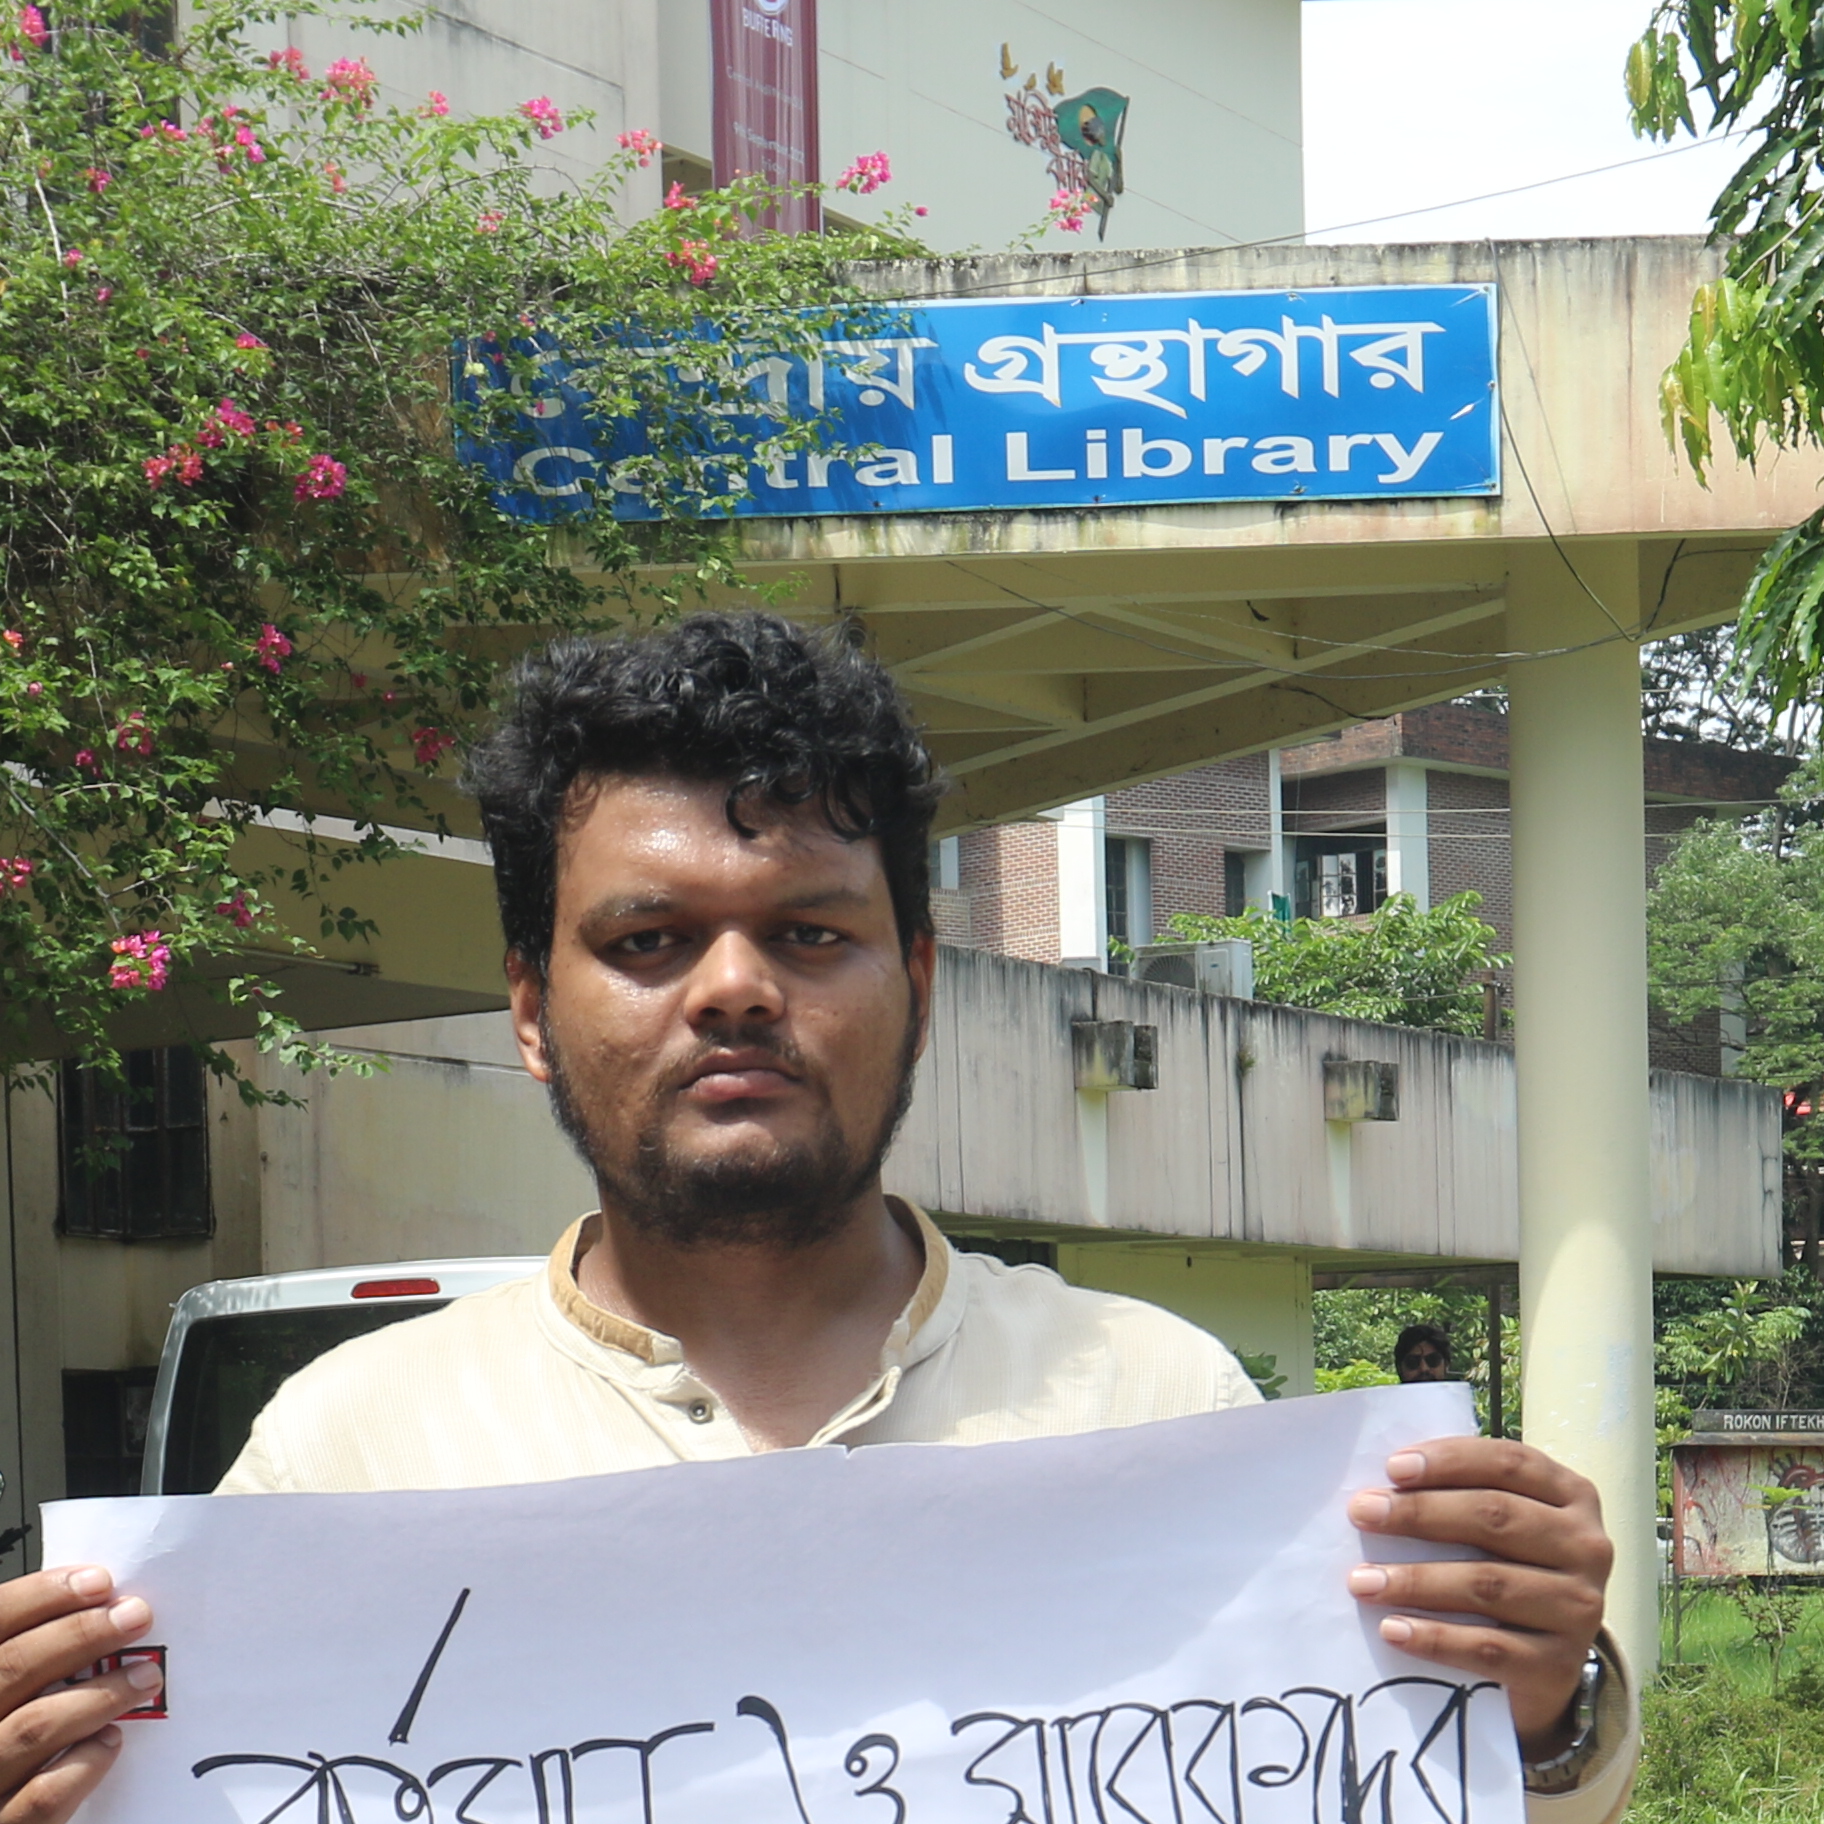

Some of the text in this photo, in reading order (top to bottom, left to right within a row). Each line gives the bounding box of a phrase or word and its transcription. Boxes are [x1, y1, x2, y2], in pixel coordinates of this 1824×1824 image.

[964, 314, 1446, 419] গ্রন্থাগার
[1005, 428, 1444, 484] Library
[1723, 1414, 1771, 1430] ROKON
